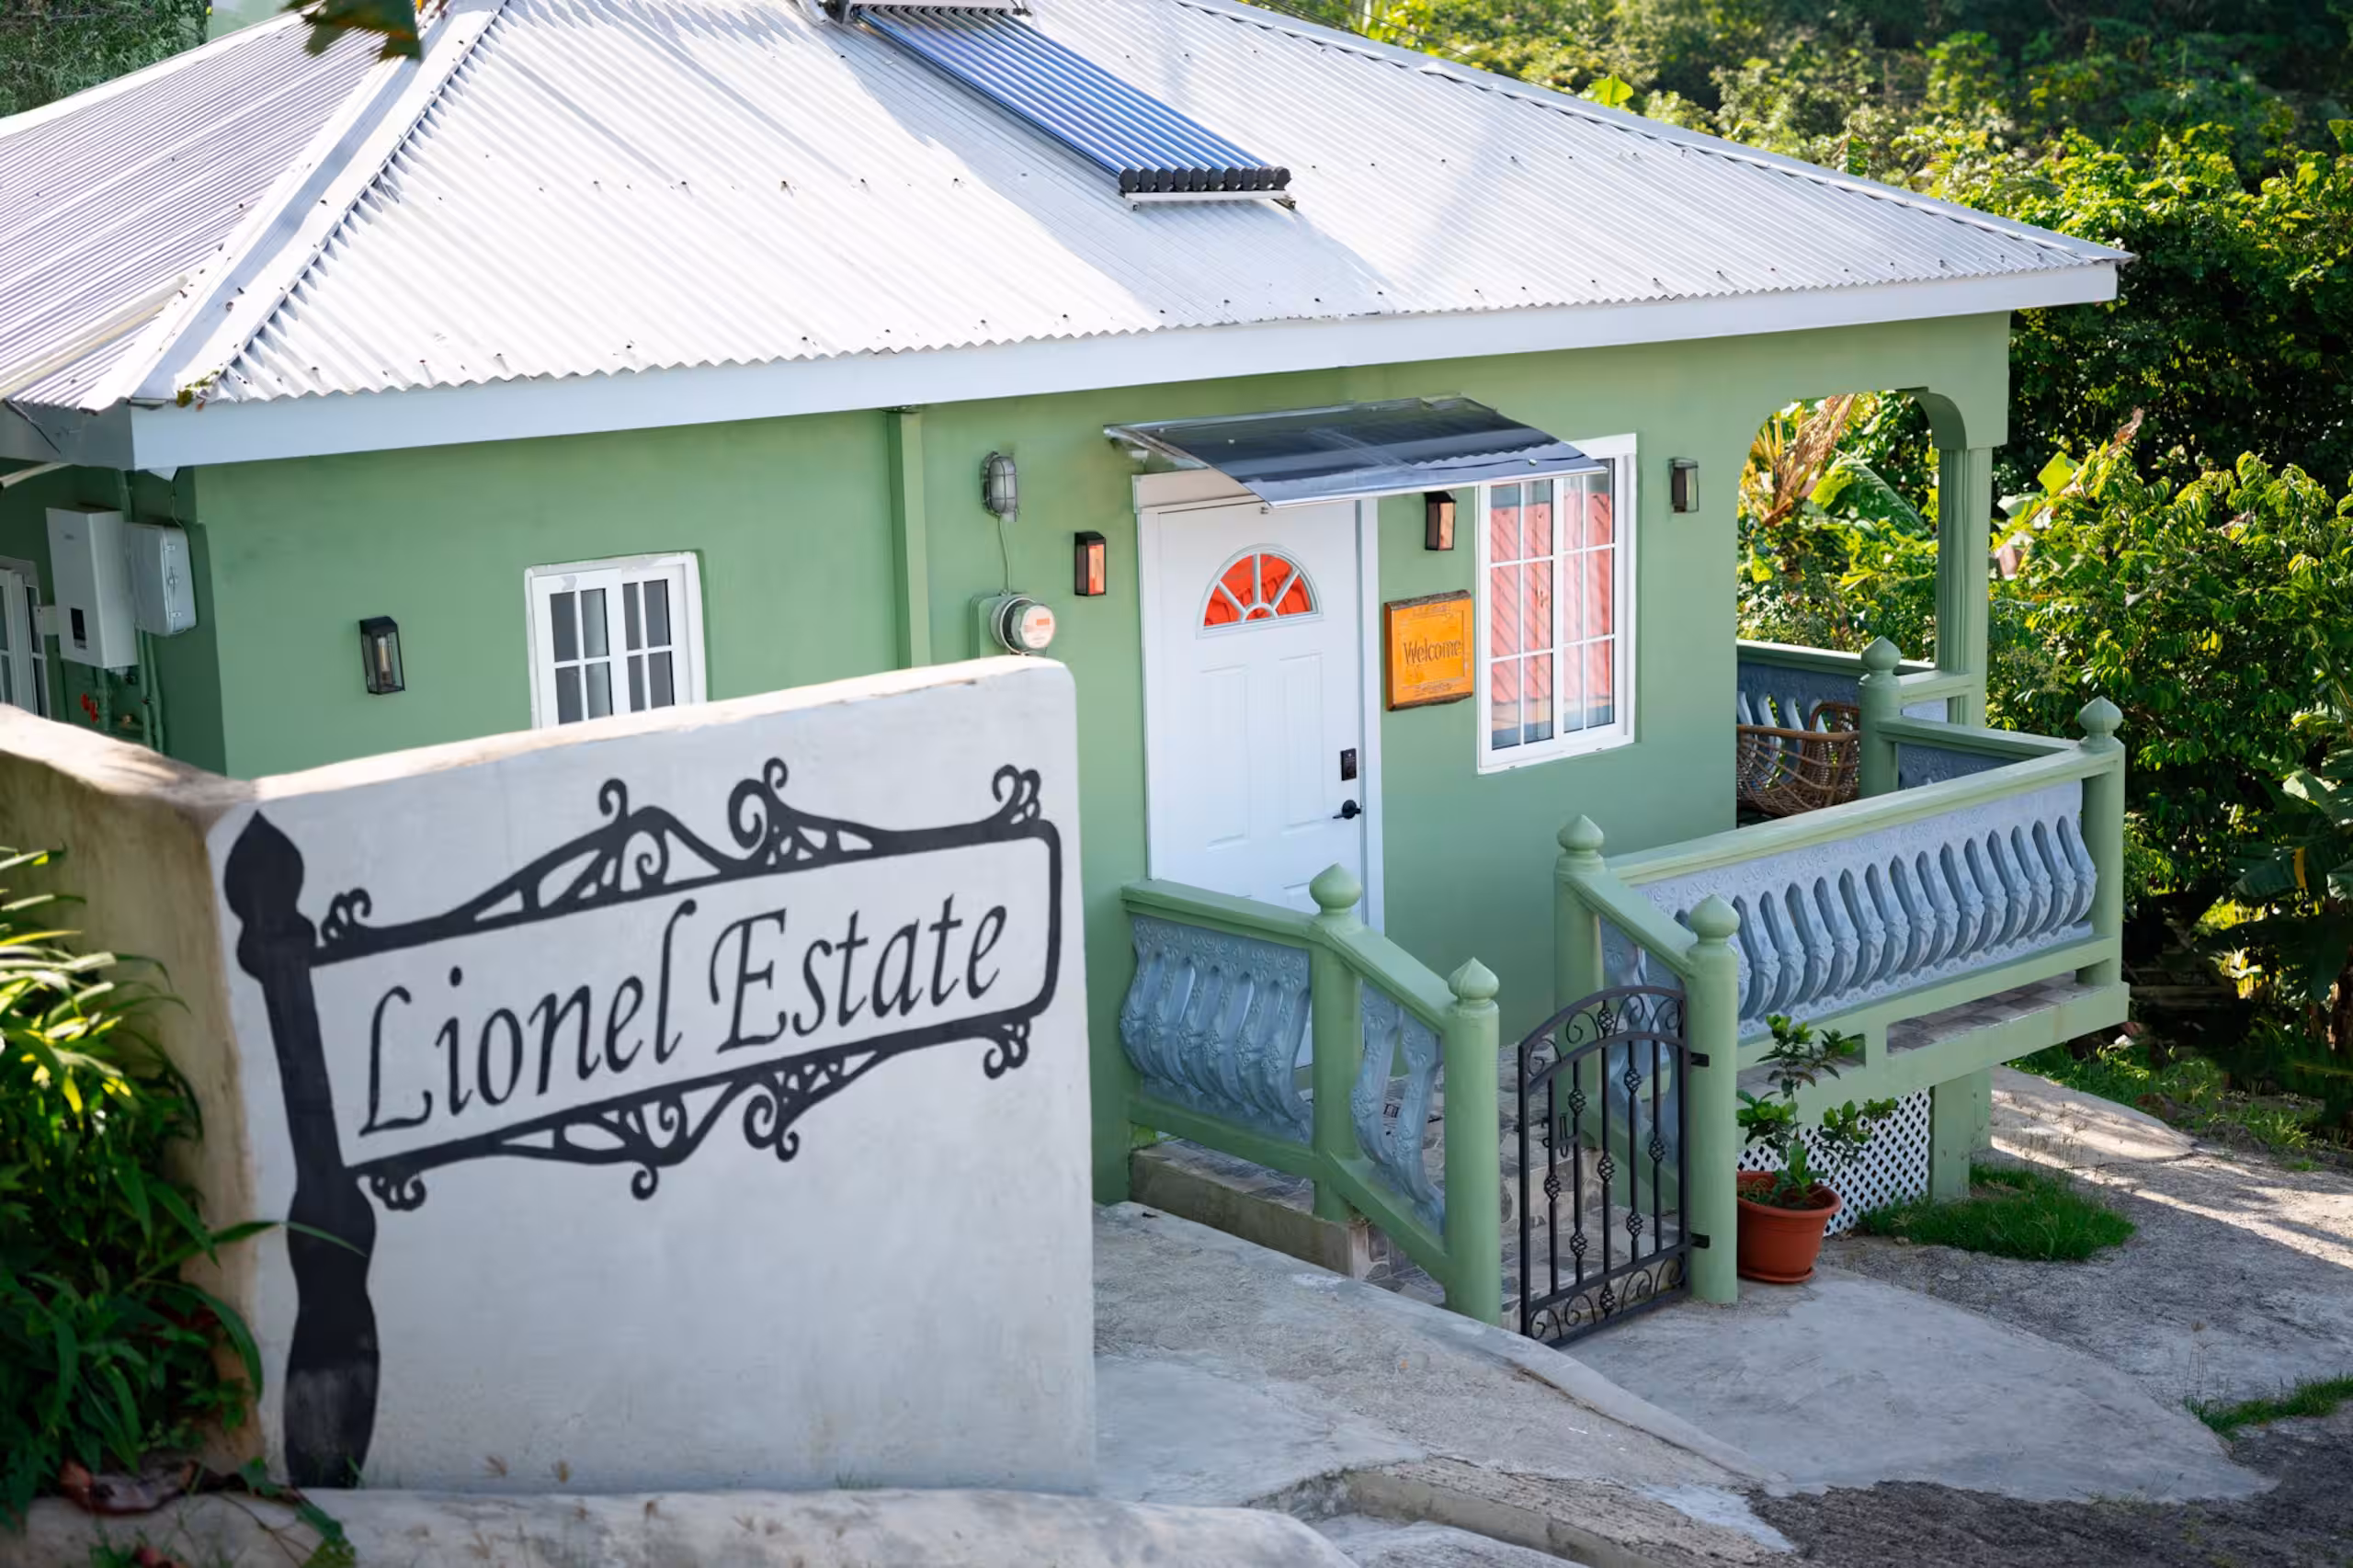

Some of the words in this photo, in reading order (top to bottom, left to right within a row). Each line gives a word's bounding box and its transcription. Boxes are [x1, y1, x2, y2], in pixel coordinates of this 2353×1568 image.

[1404, 638, 1461, 665] Welcome
[359, 898, 698, 1137] Lionel
[709, 893, 1008, 1054] Estate
